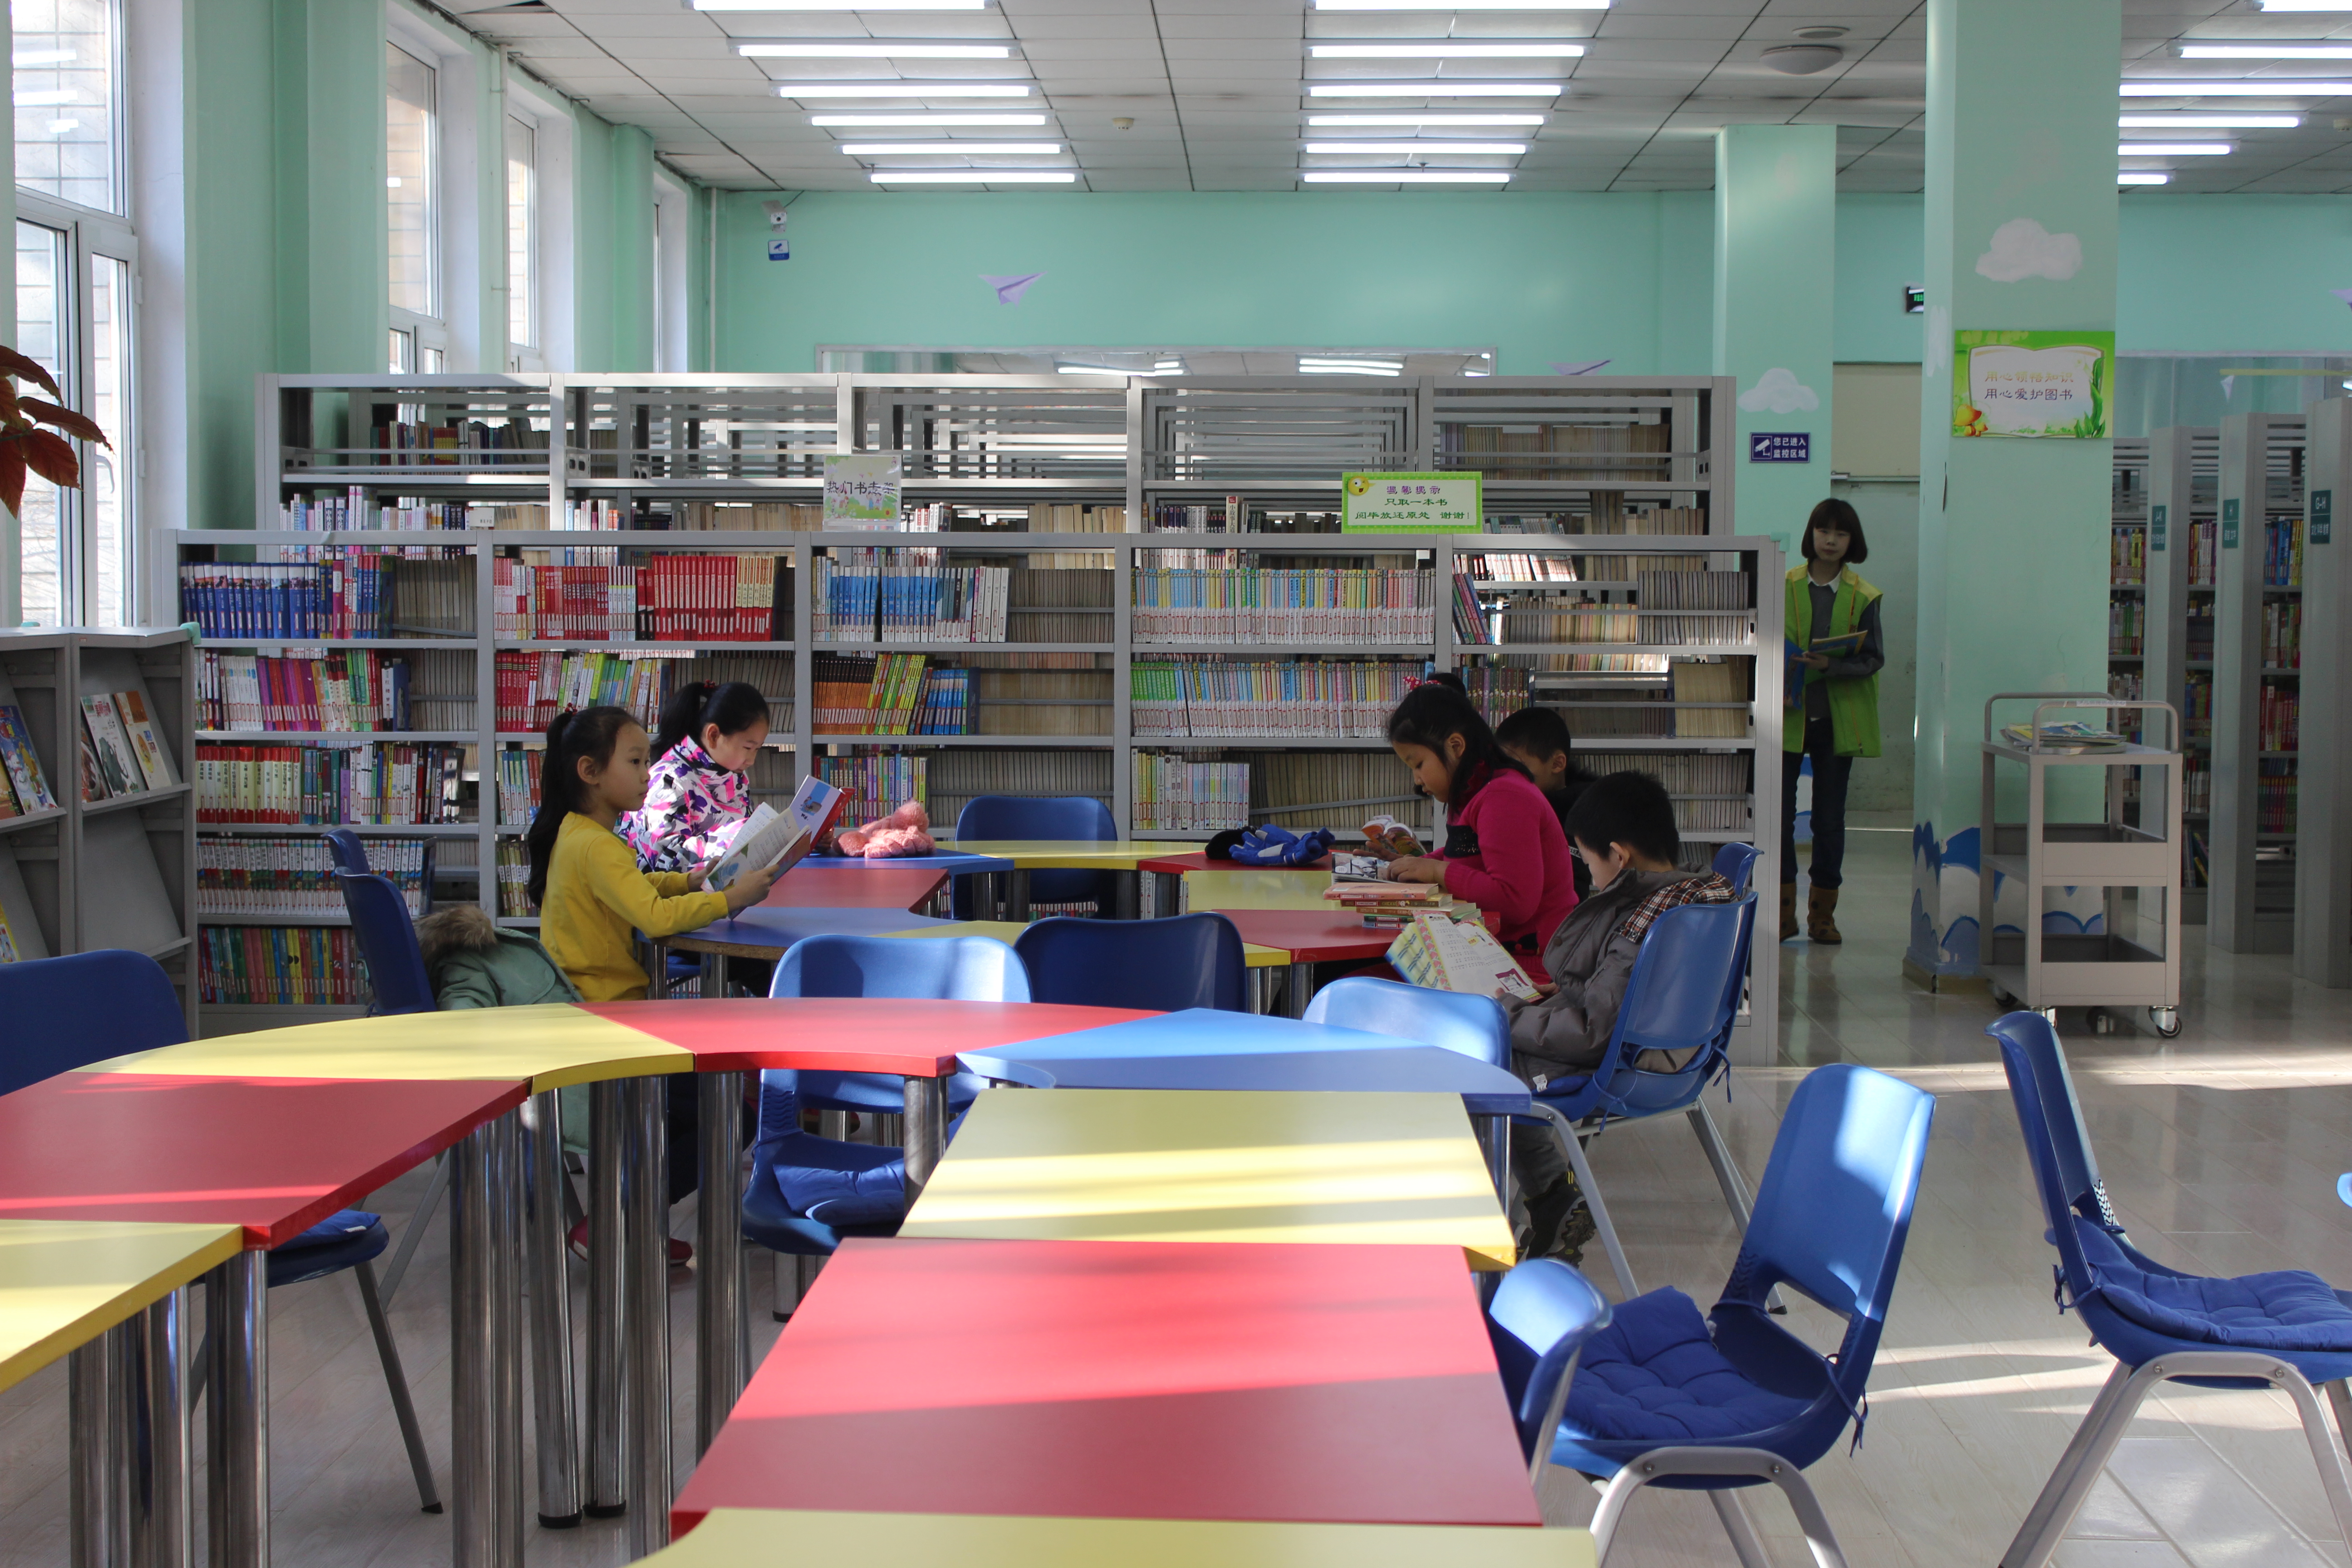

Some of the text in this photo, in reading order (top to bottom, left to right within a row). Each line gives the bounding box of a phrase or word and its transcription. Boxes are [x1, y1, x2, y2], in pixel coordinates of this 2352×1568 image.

[1984, 388, 2073, 401] 用心爱护图书
[1773, 437, 1806, 446] 您已进入
[1773, 449, 1806, 458] 监控区域
[1386, 485, 1441, 495] 温馨提示
[1384, 498, 1448, 506] 只取一本书
[1354, 511, 1430, 519] 阅毕放还原处
